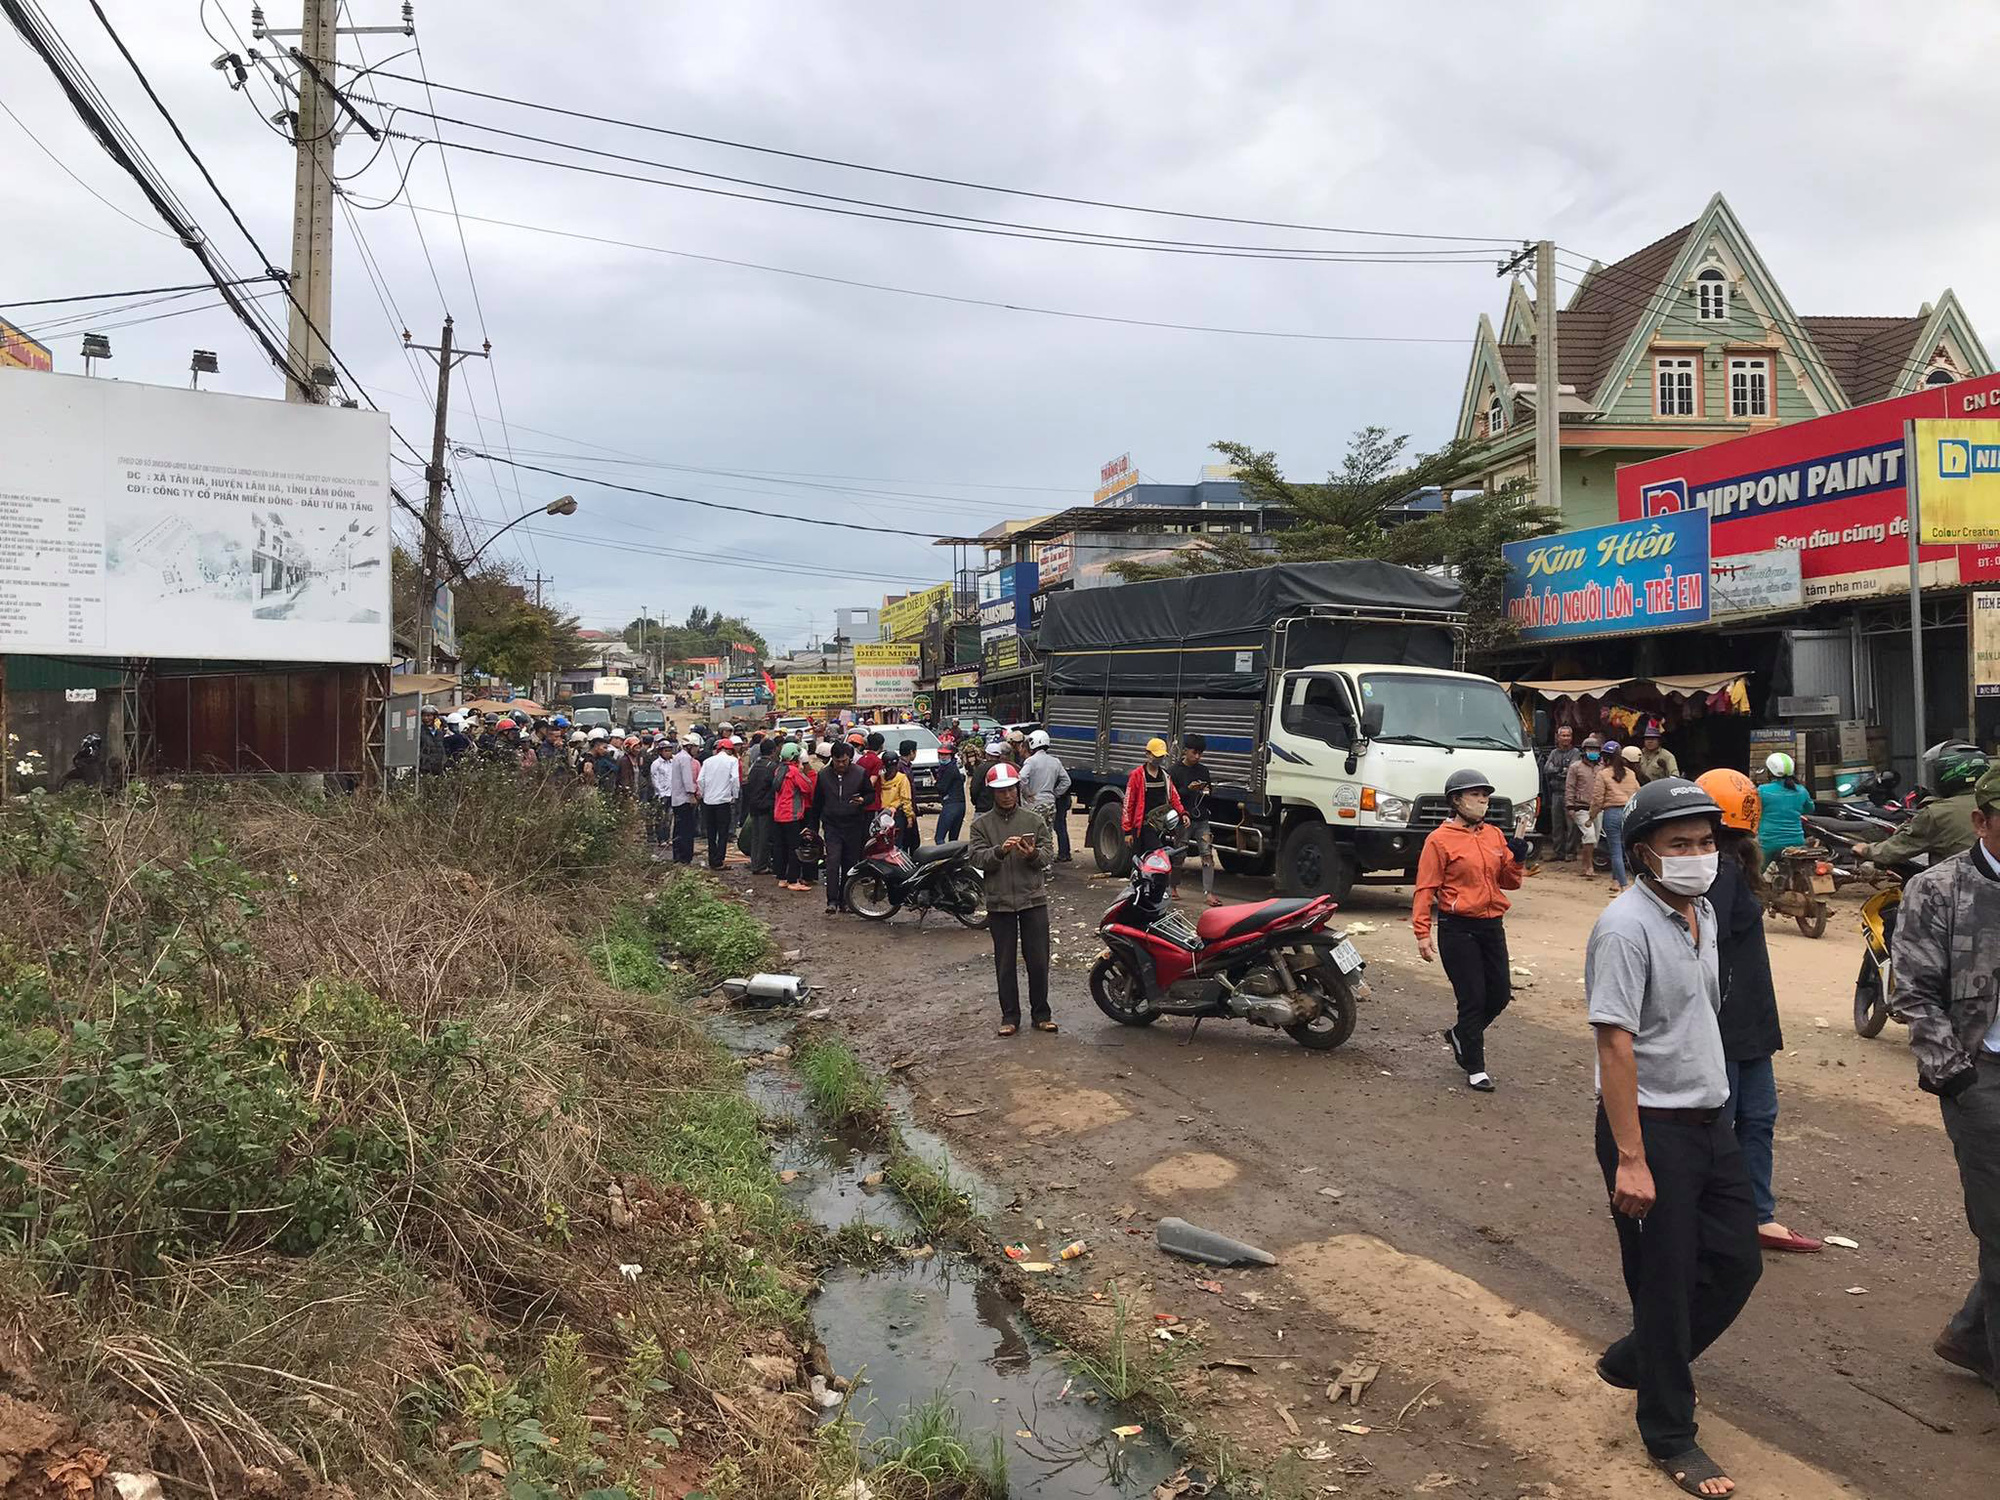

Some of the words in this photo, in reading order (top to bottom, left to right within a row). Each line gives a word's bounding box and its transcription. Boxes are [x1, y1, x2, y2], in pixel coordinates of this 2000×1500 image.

[1963, 392, 1987, 411] CN
[153, 485, 180, 496] CÔNG
[182, 489, 195, 498] TY
[1696, 471, 1800, 517] NIPPON
[1807, 449, 1904, 497] PAINT
[1842, 523, 1885, 543] cũng
[1889, 515, 1909, 538] đẹ
[1932, 527, 1961, 538] Colour
[1963, 526, 1999, 538] Creation
[1526, 544, 1588, 578] Kim
[1597, 523, 1677, 567] Hiền
[1508, 584, 1541, 629] QUẦN
[1542, 586, 1561, 625] ÁO
[1562, 579, 1603, 624] NGƯỜI
[1605, 575, 1634, 619] LỚN
[1645, 564, 1674, 614] TRẺ
[1678, 573, 1702, 610] EM
[1829, 580, 1849, 596] pha
[980, 601, 1015, 627] SAMSUNG
